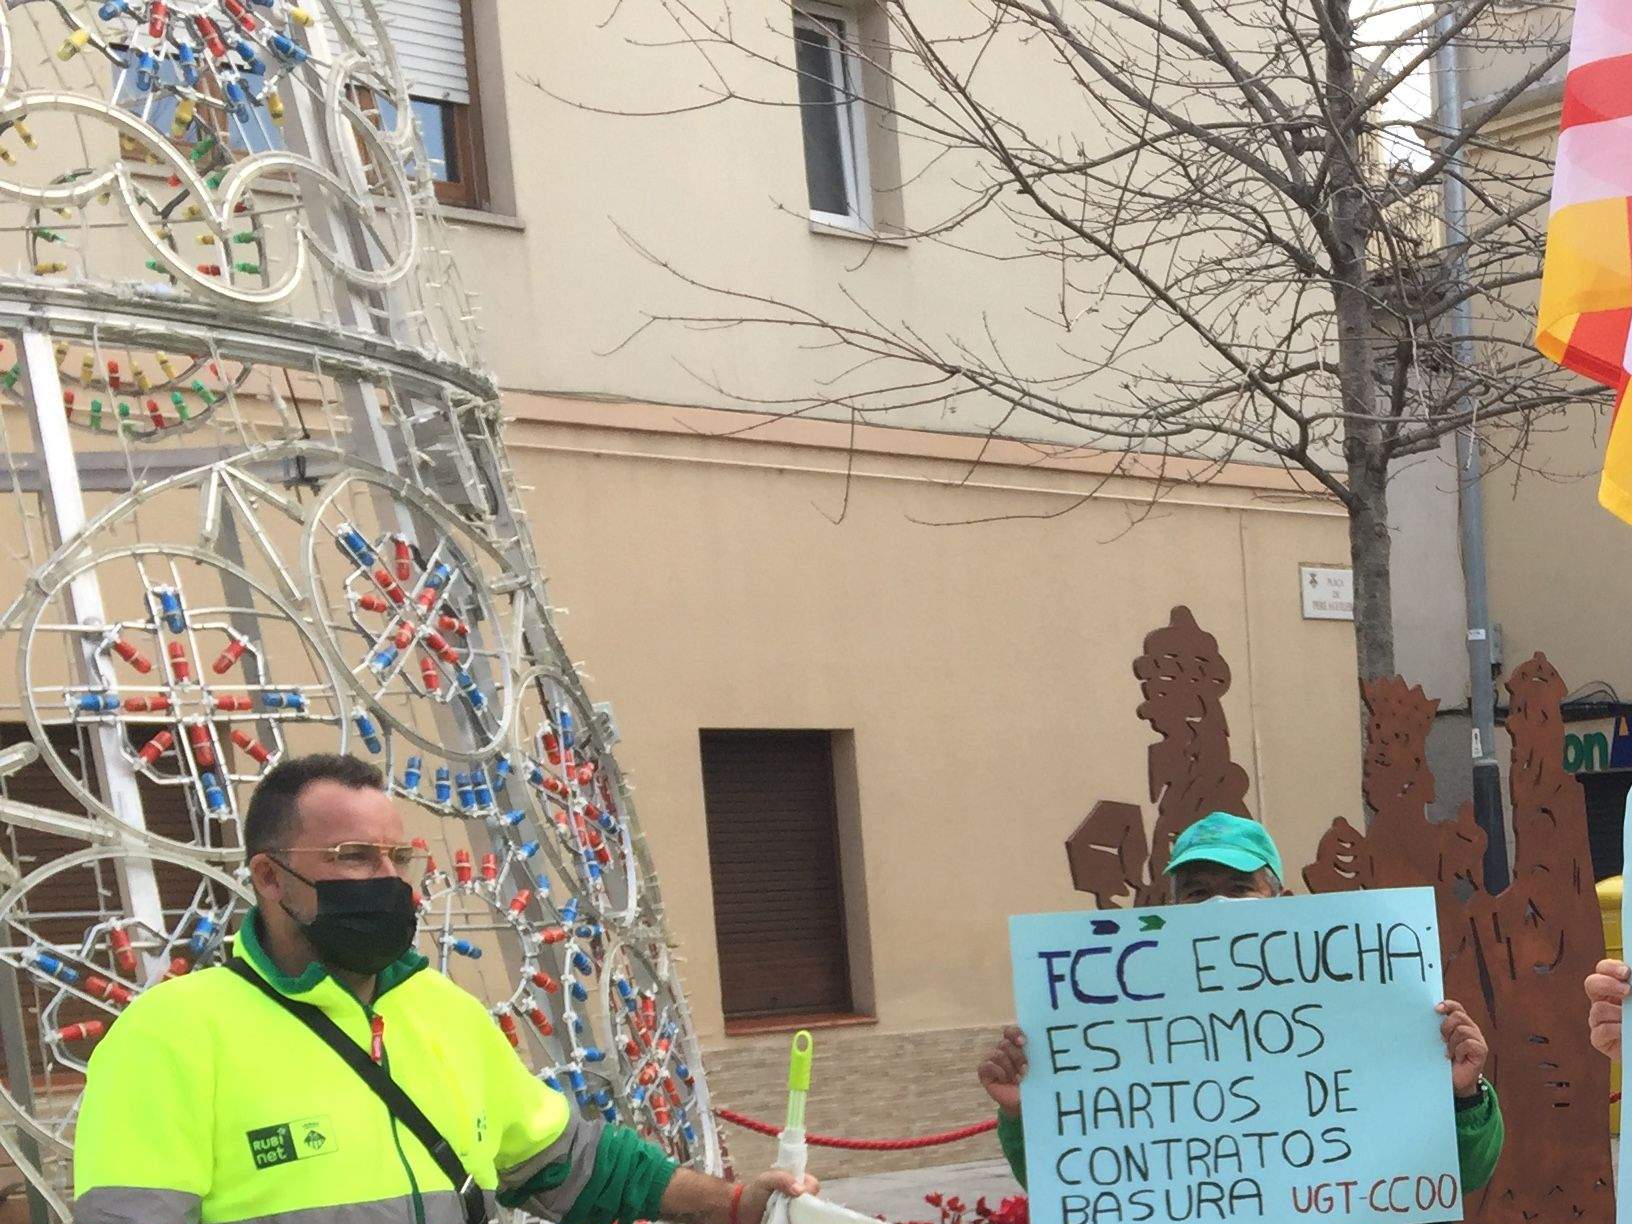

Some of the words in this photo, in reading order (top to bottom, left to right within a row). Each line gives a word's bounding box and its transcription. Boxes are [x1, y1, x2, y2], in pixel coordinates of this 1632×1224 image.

[1038, 939, 1166, 1011] FCC
[1046, 1003, 1326, 1075] ESTAMOS
[1056, 1075, 1261, 1136] HARTOS
[1305, 1069, 1358, 1118] DE
[1056, 1126, 1353, 1187] CONTRATOS
